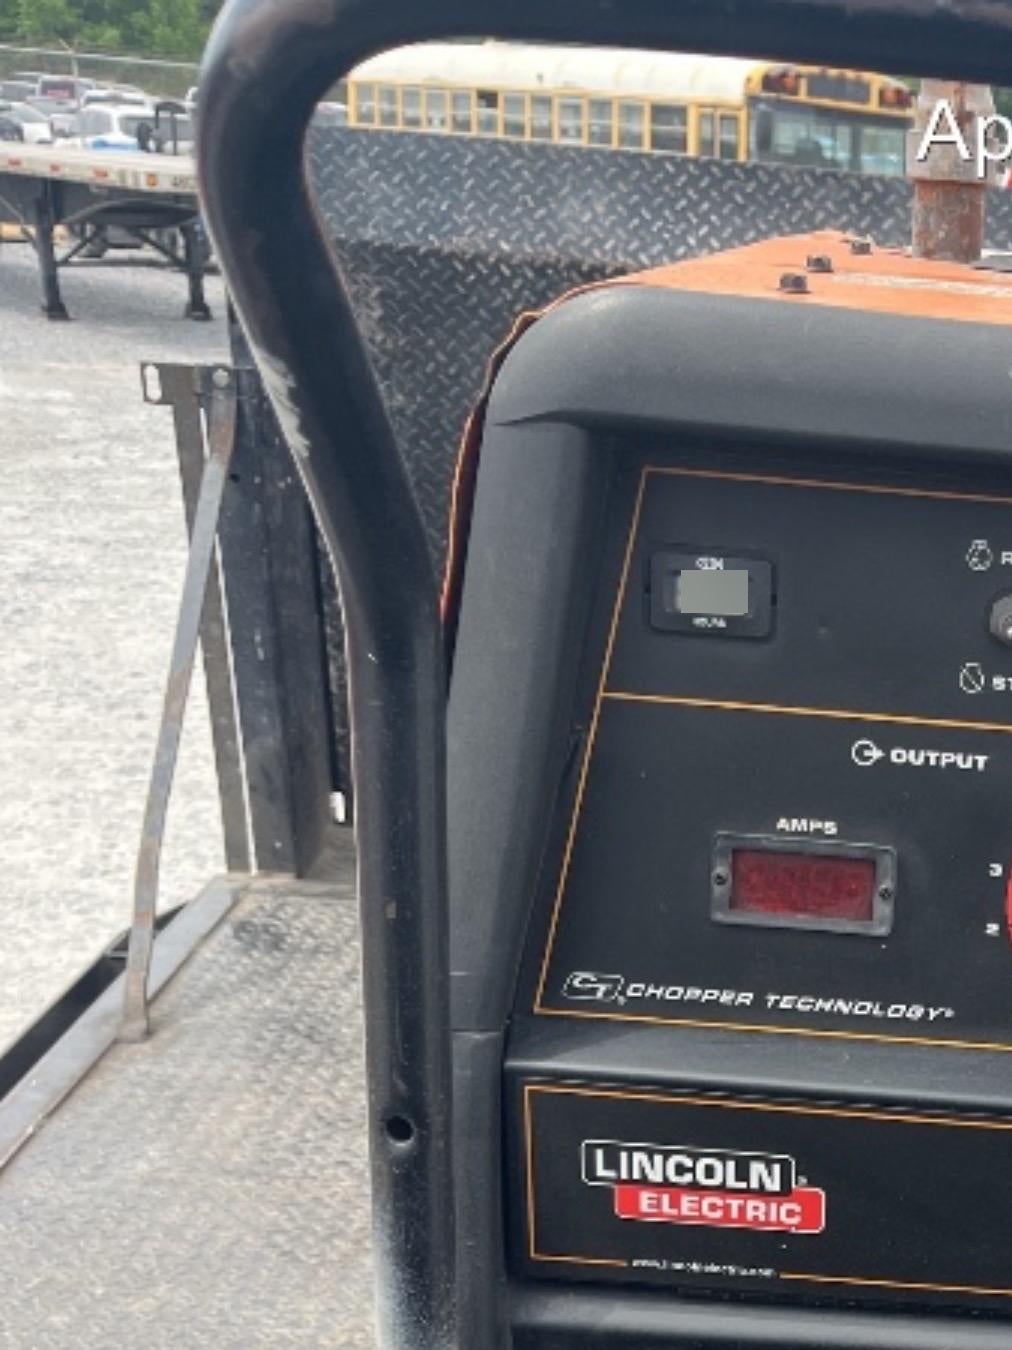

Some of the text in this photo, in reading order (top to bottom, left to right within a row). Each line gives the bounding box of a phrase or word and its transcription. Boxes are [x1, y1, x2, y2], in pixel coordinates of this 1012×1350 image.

[890, 748, 989, 771] OUTPUT
[775, 816, 839, 836] AMPS
[989, 863, 1003, 877] 3
[626, 982, 754, 1008] CHOPPER
[595, 1148, 782, 1193] LINCOLN
[639, 1191, 802, 1225] ELECTRIC
